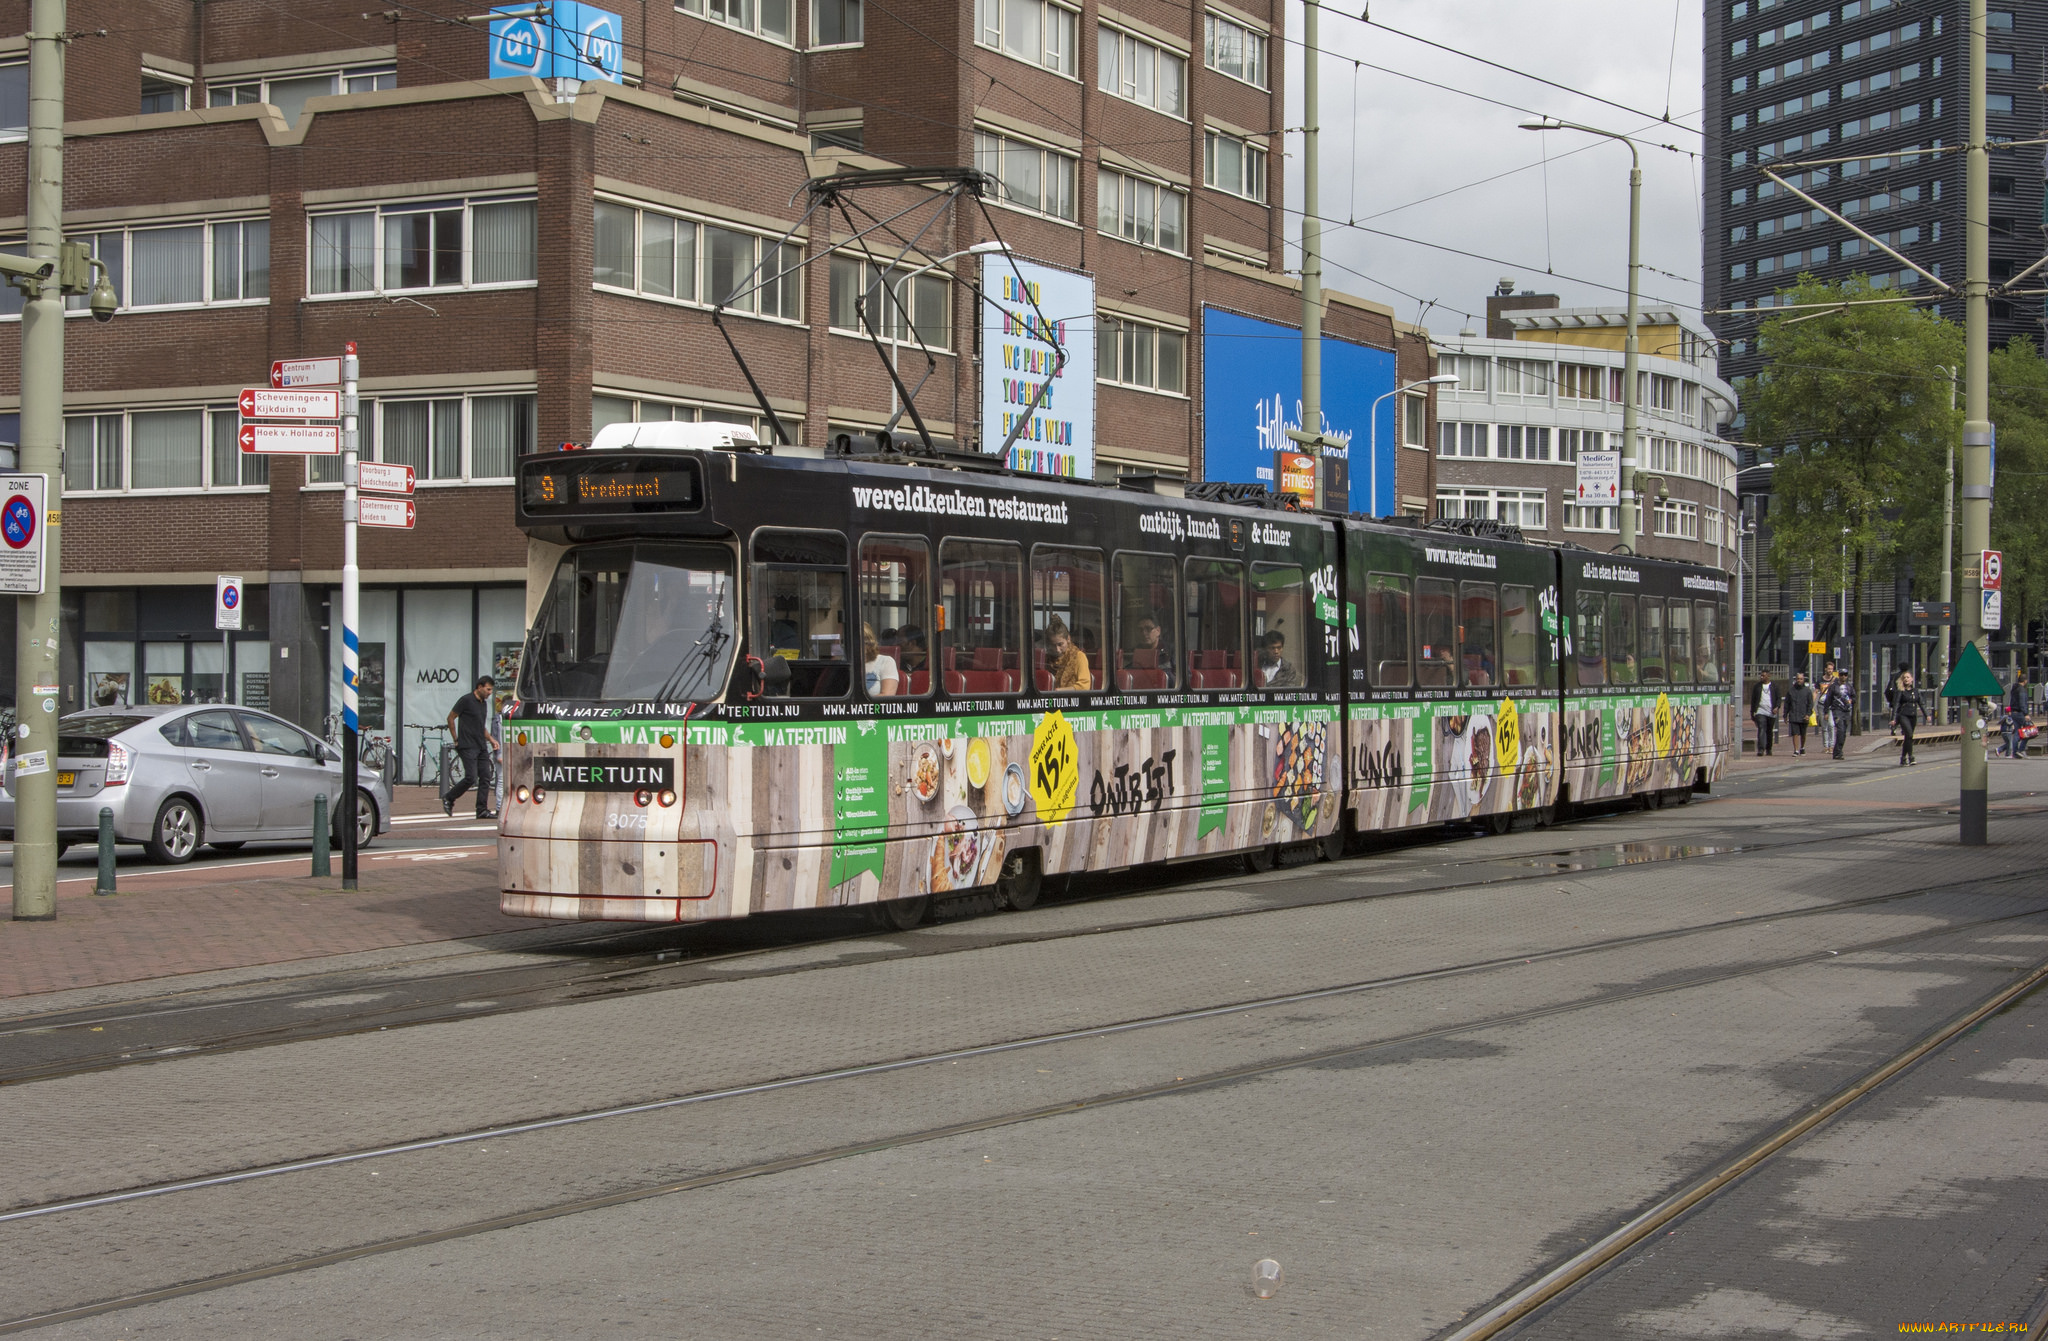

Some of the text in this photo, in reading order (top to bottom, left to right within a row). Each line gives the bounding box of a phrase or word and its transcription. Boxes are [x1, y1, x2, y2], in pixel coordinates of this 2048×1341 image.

[1003, 275, 1041, 307] BROOD
[1003, 309, 1066, 346] BIO EIEREN
[283, 364, 311, 372] Centrum
[1003, 343, 1063, 378] WC PAPIER
[256, 393, 320, 403] Scheveningen
[1003, 377, 1053, 409] YOGHURT
[256, 405, 295, 414] Kijkduin
[731, 431, 751, 439] DENSO
[1003, 411, 1073, 446] FLESJE WIJN
[362, 465, 386, 476] Voorburg
[1047, 451, 1076, 479] VOOR
[1283, 464, 1290, 473] 24
[8, 481, 29, 490] ZONE
[362, 478, 399, 487] Leidschendam
[1282, 473, 1314, 490] FITNESS
[362, 501, 392, 510] Zoetermeer
[852, 485, 1069, 525] wereldkeuken restaurant
[1140, 511, 1185, 543] ontbijt,
[1187, 515, 1221, 540] lunch
[1251, 521, 1261, 543] &
[1262, 523, 1292, 547] diner
[1425, 547, 1497, 569] www.watertuin.nu
[1583, 562, 1598, 578] all-in
[1599, 563, 1612, 580] eten
[1617, 565, 1640, 583] drinken
[416, 668, 459, 683] MADO
[1352, 669, 1364, 680] 3075
[1016, 698, 1080, 709] WWW.WATERTUIN.NU
[1090, 695, 1148, 706] WWW.WATERTUIN.NU
[1157, 694, 1210, 704] WWW.WATERTUIN.NU
[1218, 693, 1266, 703] WWW.WATERTUIN.NU
[1273, 692, 1318, 702] WWW.WATERTUIN.NU
[823, 703, 919, 716] WWW.WATERTUIN.NU
[935, 700, 1005, 712] WWW.WATERTUIN.NU
[1120, 713, 1161, 729] WATERTUIN
[1254, 709, 1288, 724] WATERTUIN
[764, 727, 847, 746] WATERTUIN
[887, 723, 949, 743] WATERTUIN
[977, 719, 1026, 738] WATERTUIN
[1498, 719, 1516, 756] 15%
[1037, 733, 1070, 800] 15%
[1350, 740, 1402, 790] LUNCH
[541, 766, 664, 784] WATERTUIN
[1089, 748, 1177, 818] ONTBIJT
[607, 813, 648, 829] 3075
